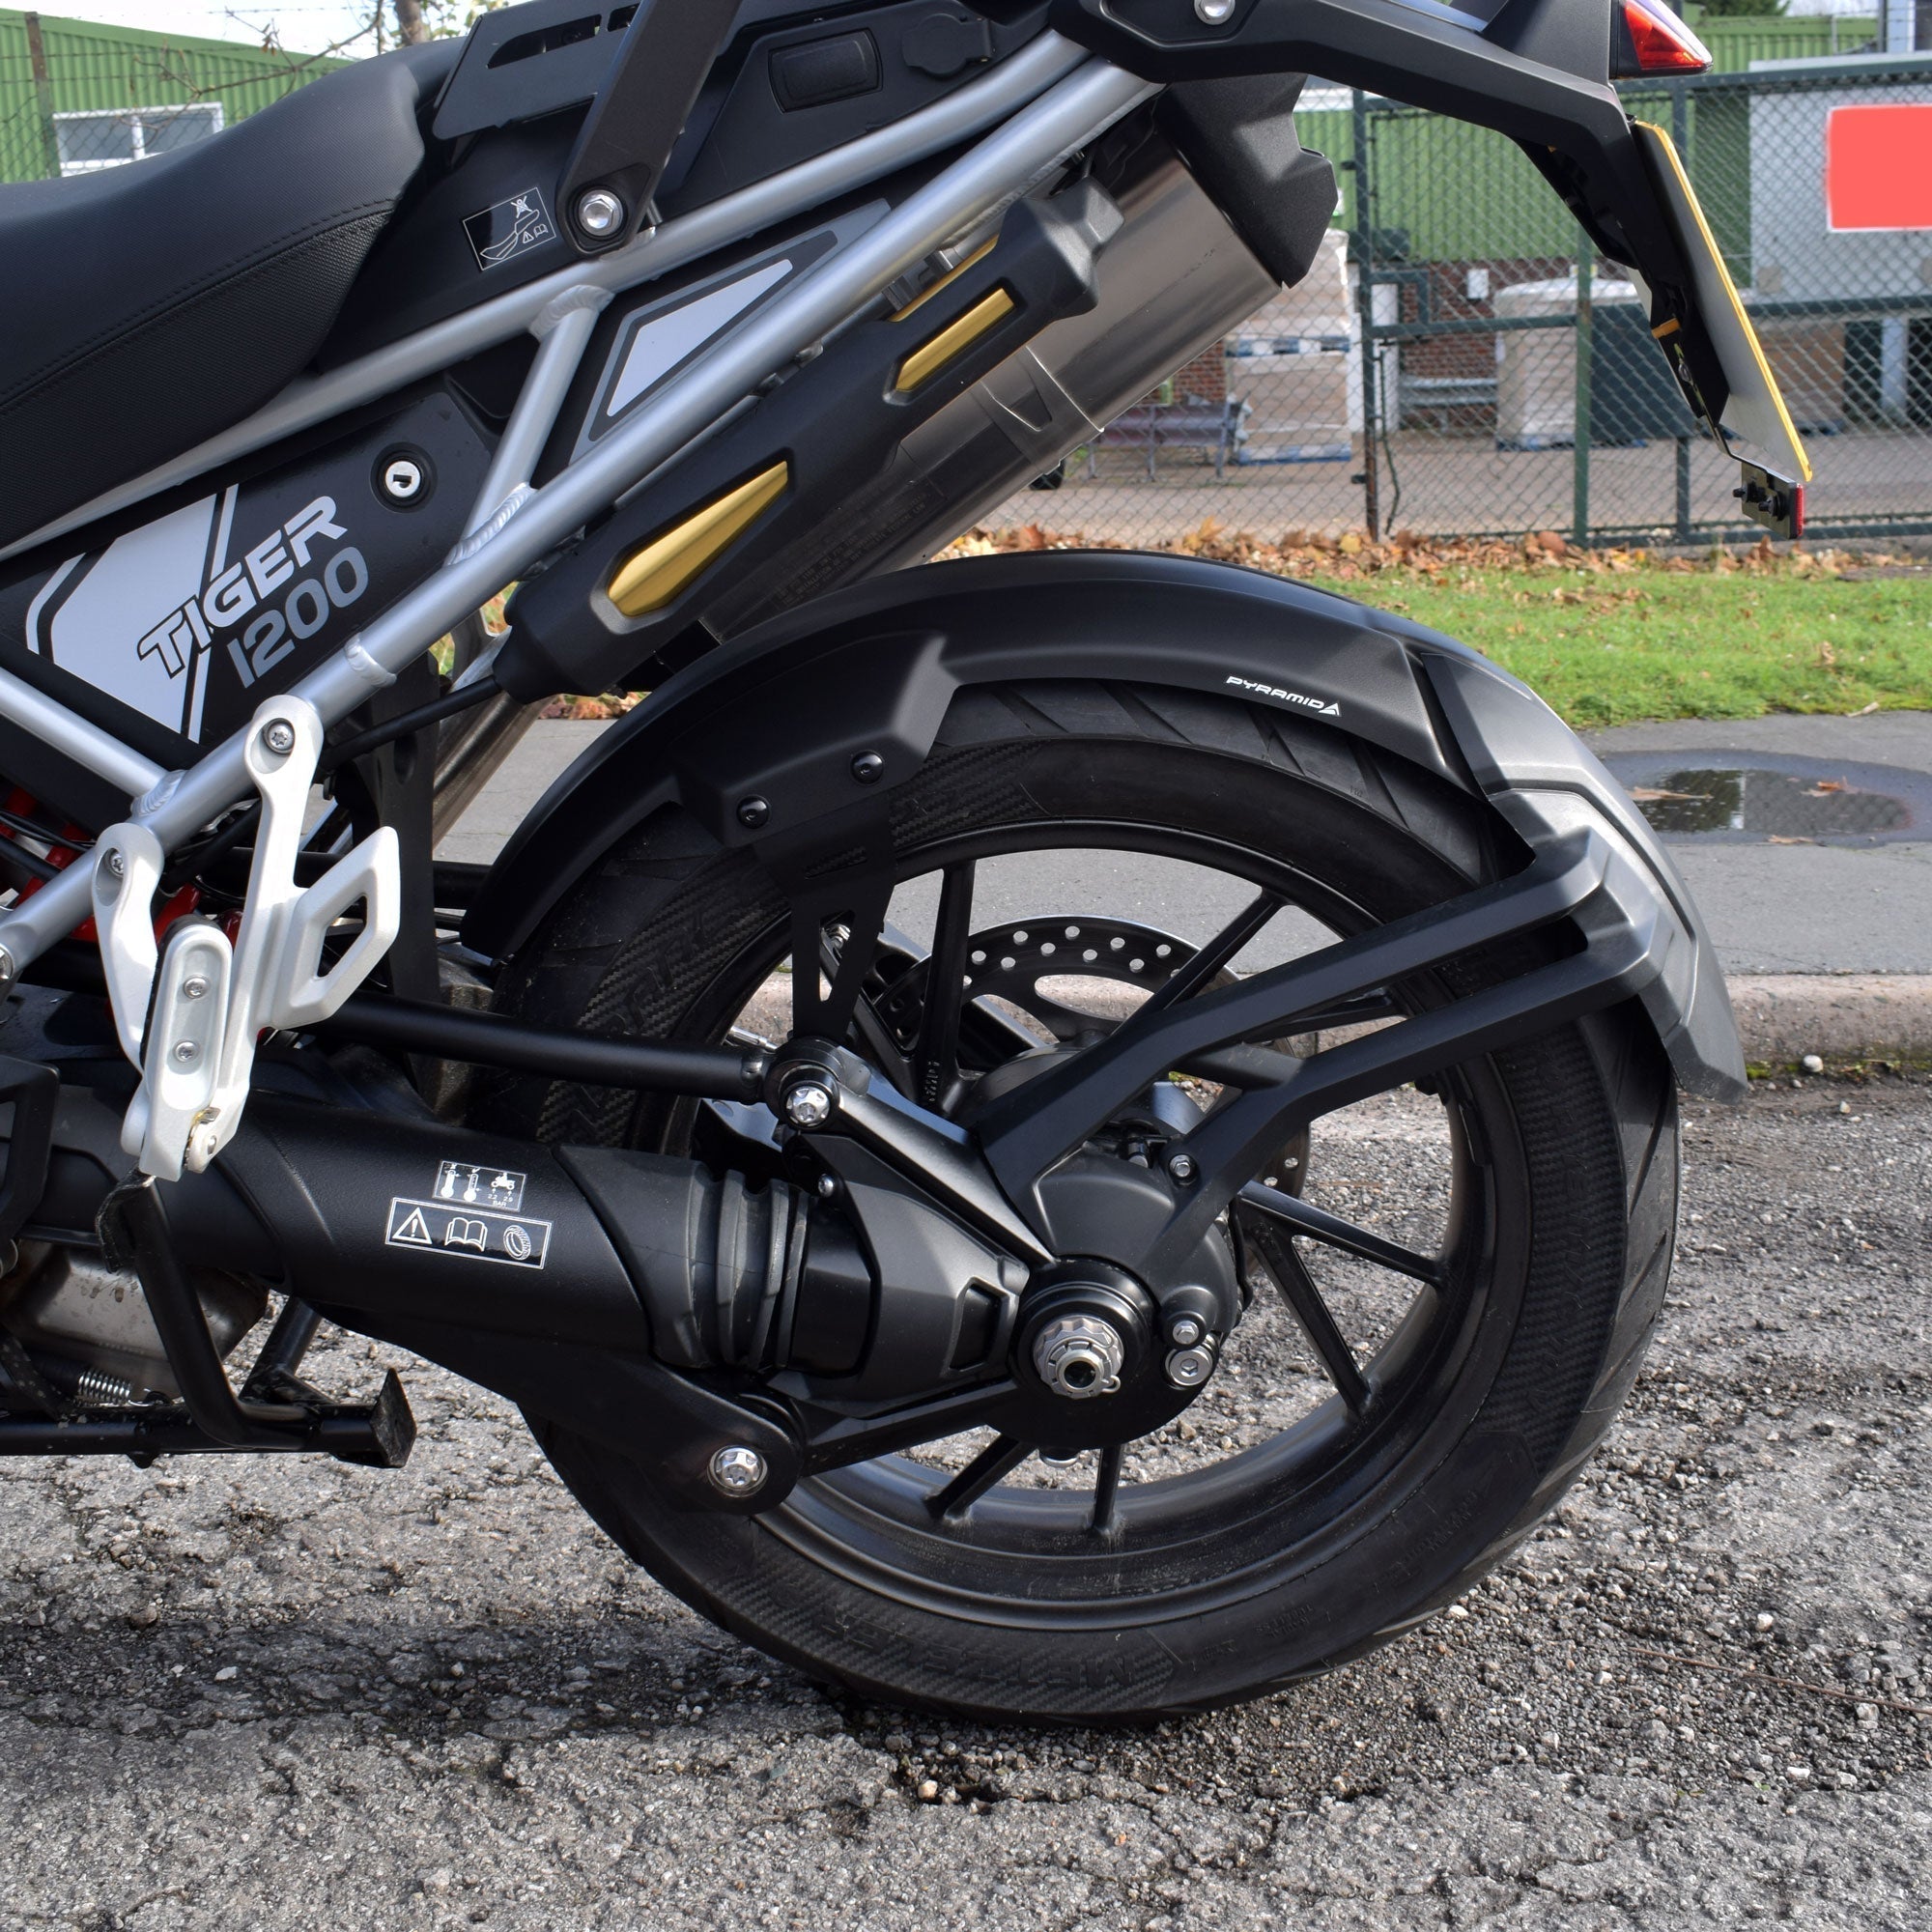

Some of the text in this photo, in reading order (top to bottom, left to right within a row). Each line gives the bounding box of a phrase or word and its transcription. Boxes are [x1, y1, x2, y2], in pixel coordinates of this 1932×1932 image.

[136, 495, 349, 680] TIGER
[226, 546, 369, 689] 1200
[1225, 675, 1325, 710] PYRAMID
